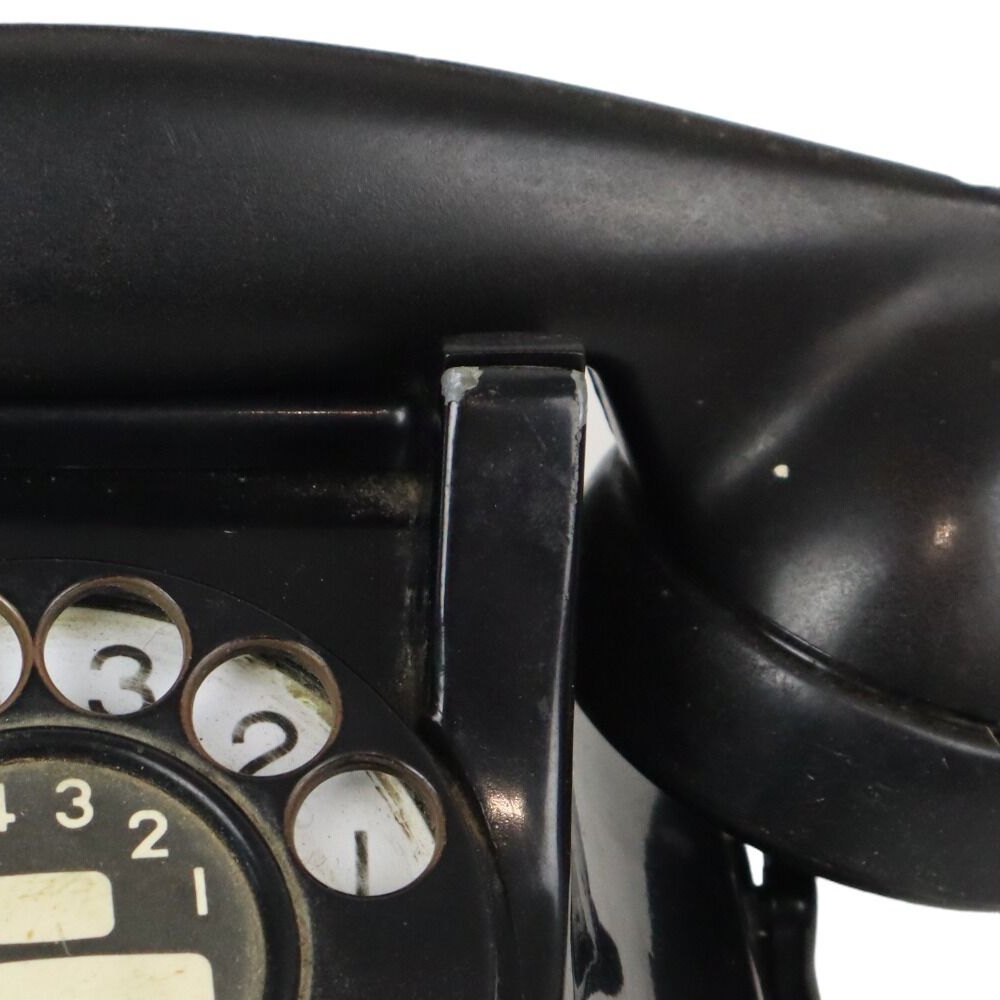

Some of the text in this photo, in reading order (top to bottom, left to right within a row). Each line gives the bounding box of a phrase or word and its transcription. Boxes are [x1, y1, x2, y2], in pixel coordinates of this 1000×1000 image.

[88, 644, 156, 715] 3
[231, 710, 299, 776] 2
[55, 777, 95, 830] 3
[127, 808, 170, 860] 2
[353, 829, 370, 897] 1
[192, 866, 209, 917] 1
